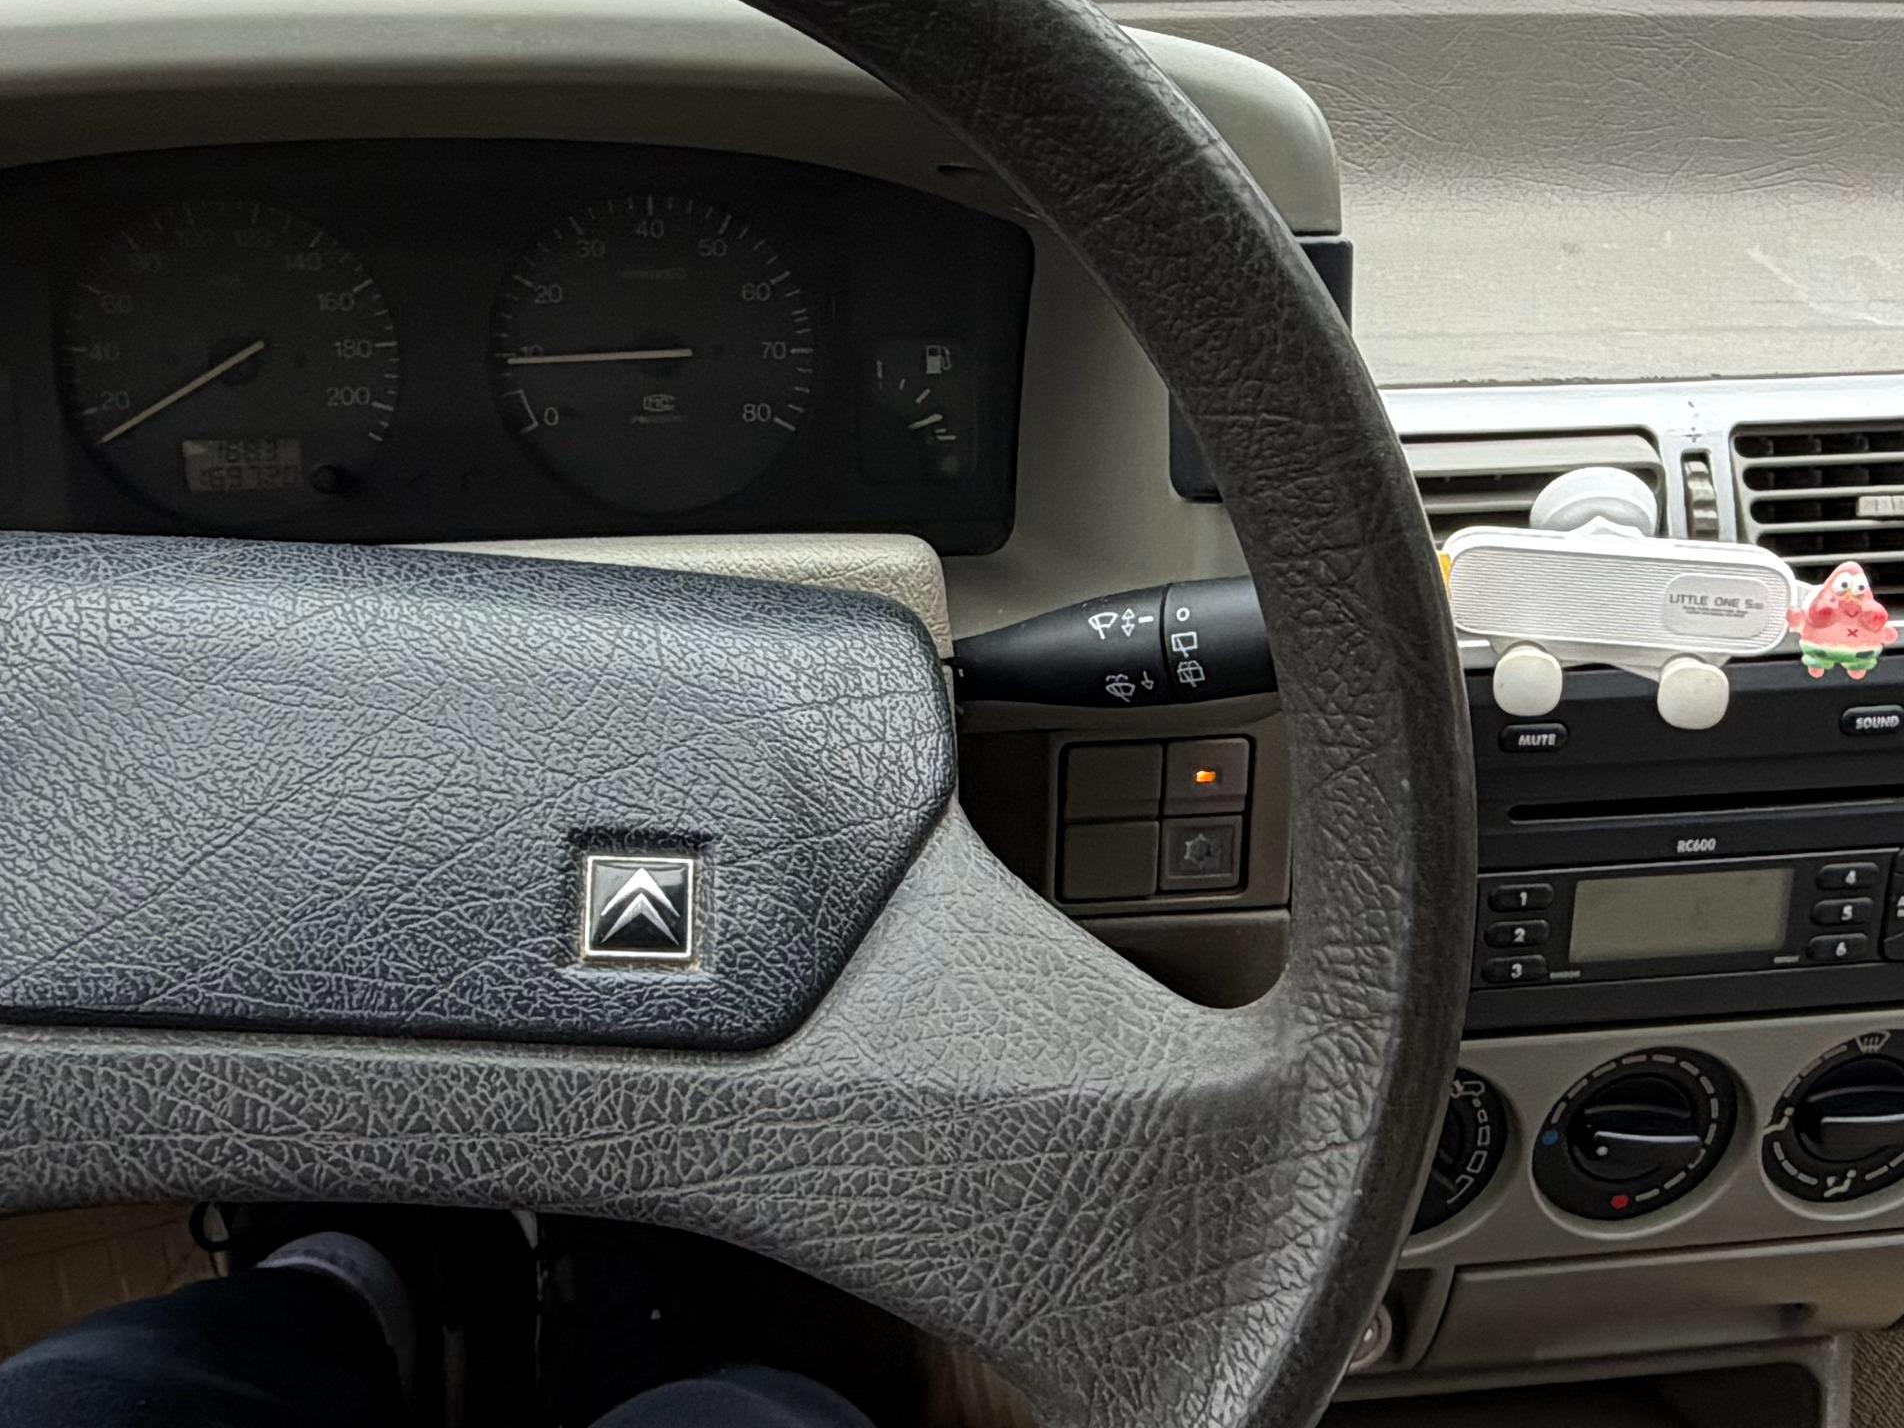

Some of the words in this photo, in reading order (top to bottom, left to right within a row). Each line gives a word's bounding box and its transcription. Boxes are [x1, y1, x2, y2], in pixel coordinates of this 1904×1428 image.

[635, 219, 665, 239] 40
[575, 240, 607, 259] 30
[697, 239, 728, 258] 50
[284, 253, 323, 272] 140
[319, 291, 356, 312] 160
[534, 283, 563, 304] 20
[741, 282, 772, 302] 60
[88, 343, 121, 362] 40
[334, 339, 374, 360] 180
[760, 341, 788, 360] 70
[100, 391, 131, 411] 20
[326, 385, 371, 407] 200
[543, 407, 560, 427] 0
[741, 403, 772, 423] 80
[1669, 593, 1710, 606] LITTLE
[1714, 596, 1741, 608] ONE
[1855, 715, 1901, 730] SOUND
[1518, 733, 1557, 747] MUTE
[1676, 838, 1717, 853] RC600
[1845, 870, 1857, 885] 4
[1519, 891, 1528, 907] 1
[1840, 904, 1853, 921] 5
[1513, 927, 1526, 943] 2
[1835, 941, 1847, 957] 6
[1510, 963, 1523, 979] 3
